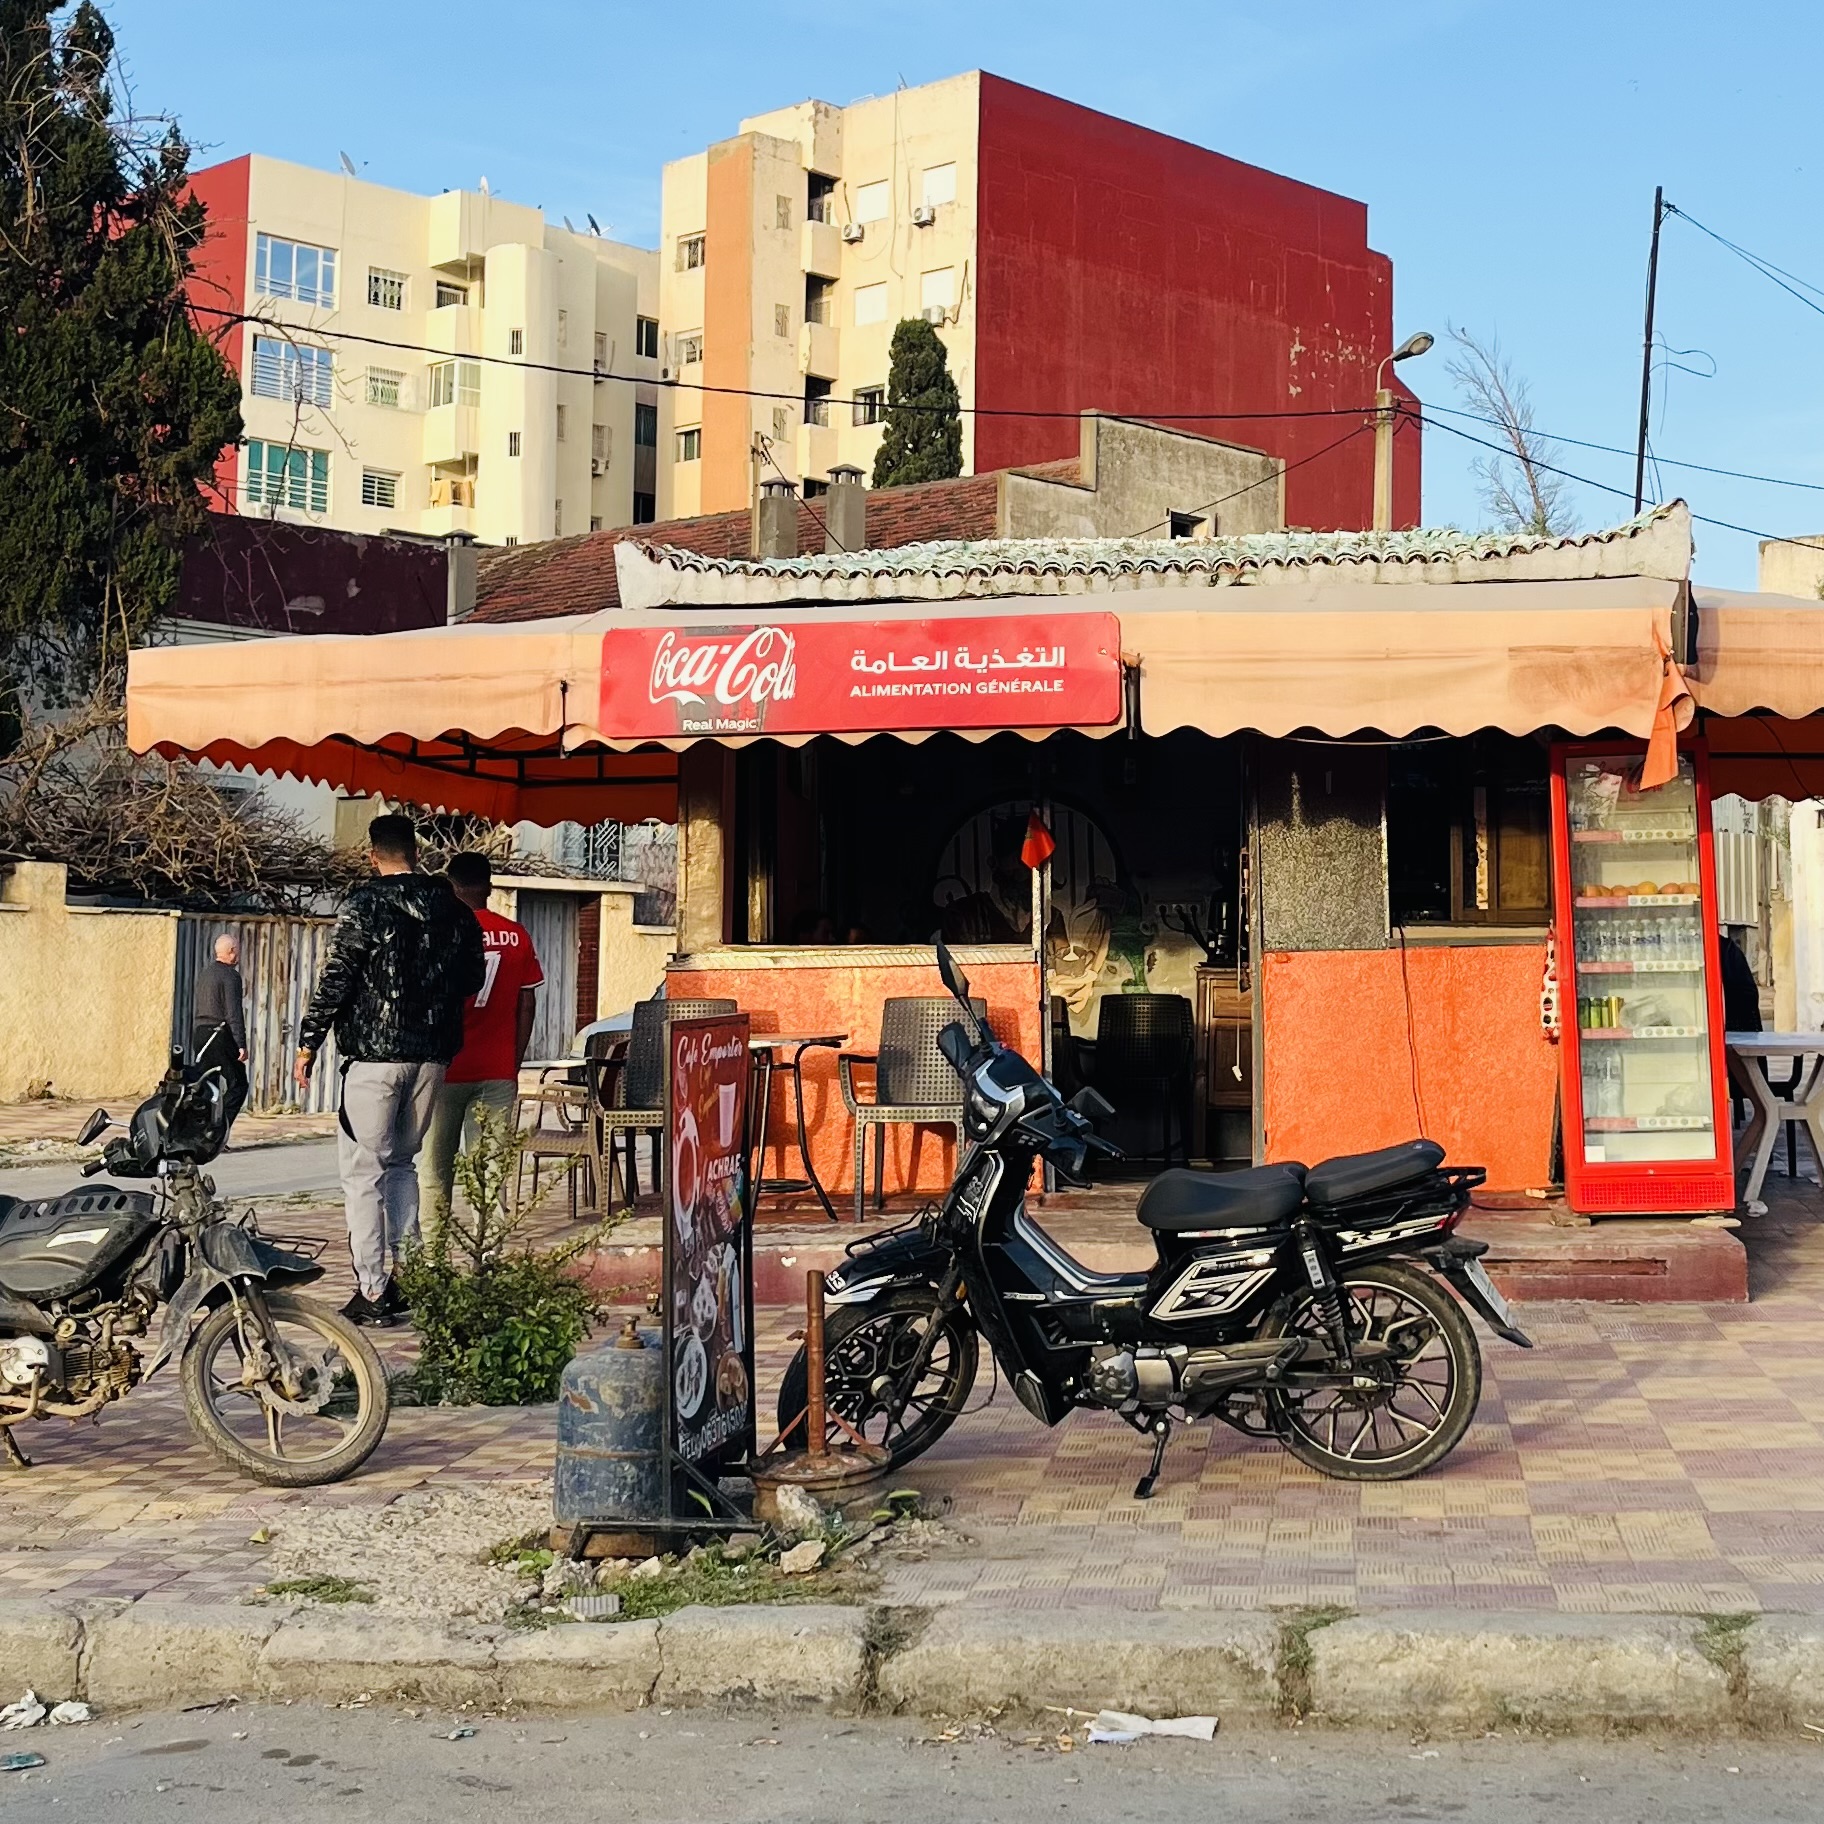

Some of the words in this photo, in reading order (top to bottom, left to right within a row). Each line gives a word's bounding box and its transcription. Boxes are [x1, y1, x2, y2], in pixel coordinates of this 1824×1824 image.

[649, 626, 796, 706] Coca-Cola
[850, 649, 949, 674] العامة
[954, 646, 1066, 674] التغذية
[850, 682, 972, 697] ALIMENTATION
[976, 678, 1065, 694] GÉNÉRALE
[682, 718, 713, 731] Real
[474, 950, 501, 1008] 7
